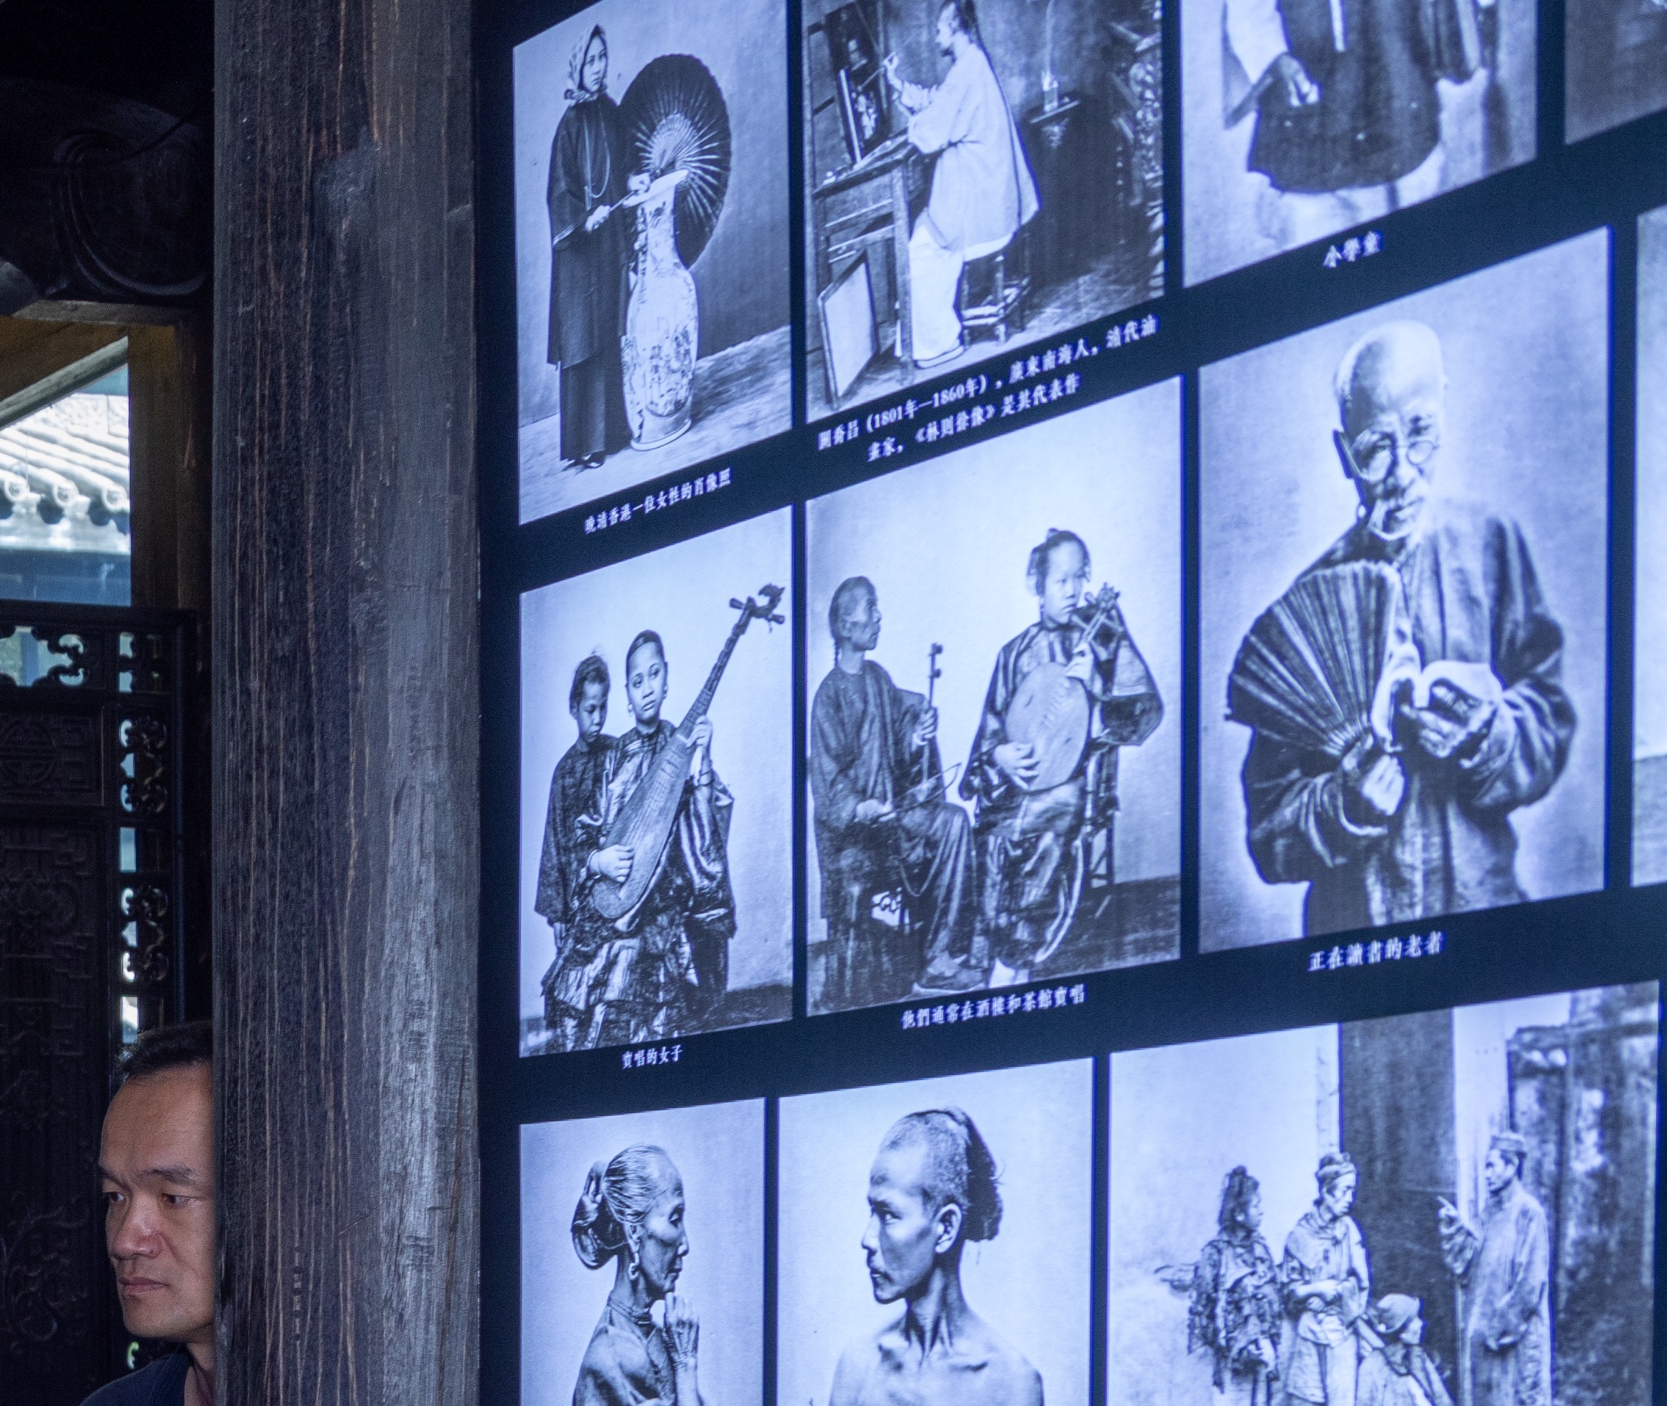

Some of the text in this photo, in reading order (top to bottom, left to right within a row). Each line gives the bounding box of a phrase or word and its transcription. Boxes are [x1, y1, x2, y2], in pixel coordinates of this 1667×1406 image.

[584, 467, 732, 535] 晚清香港一位女性的肖像照
[1307, 931, 1443, 971] 正在讀書的老者
[622, 1044, 683, 1069] 賣唱的女子
